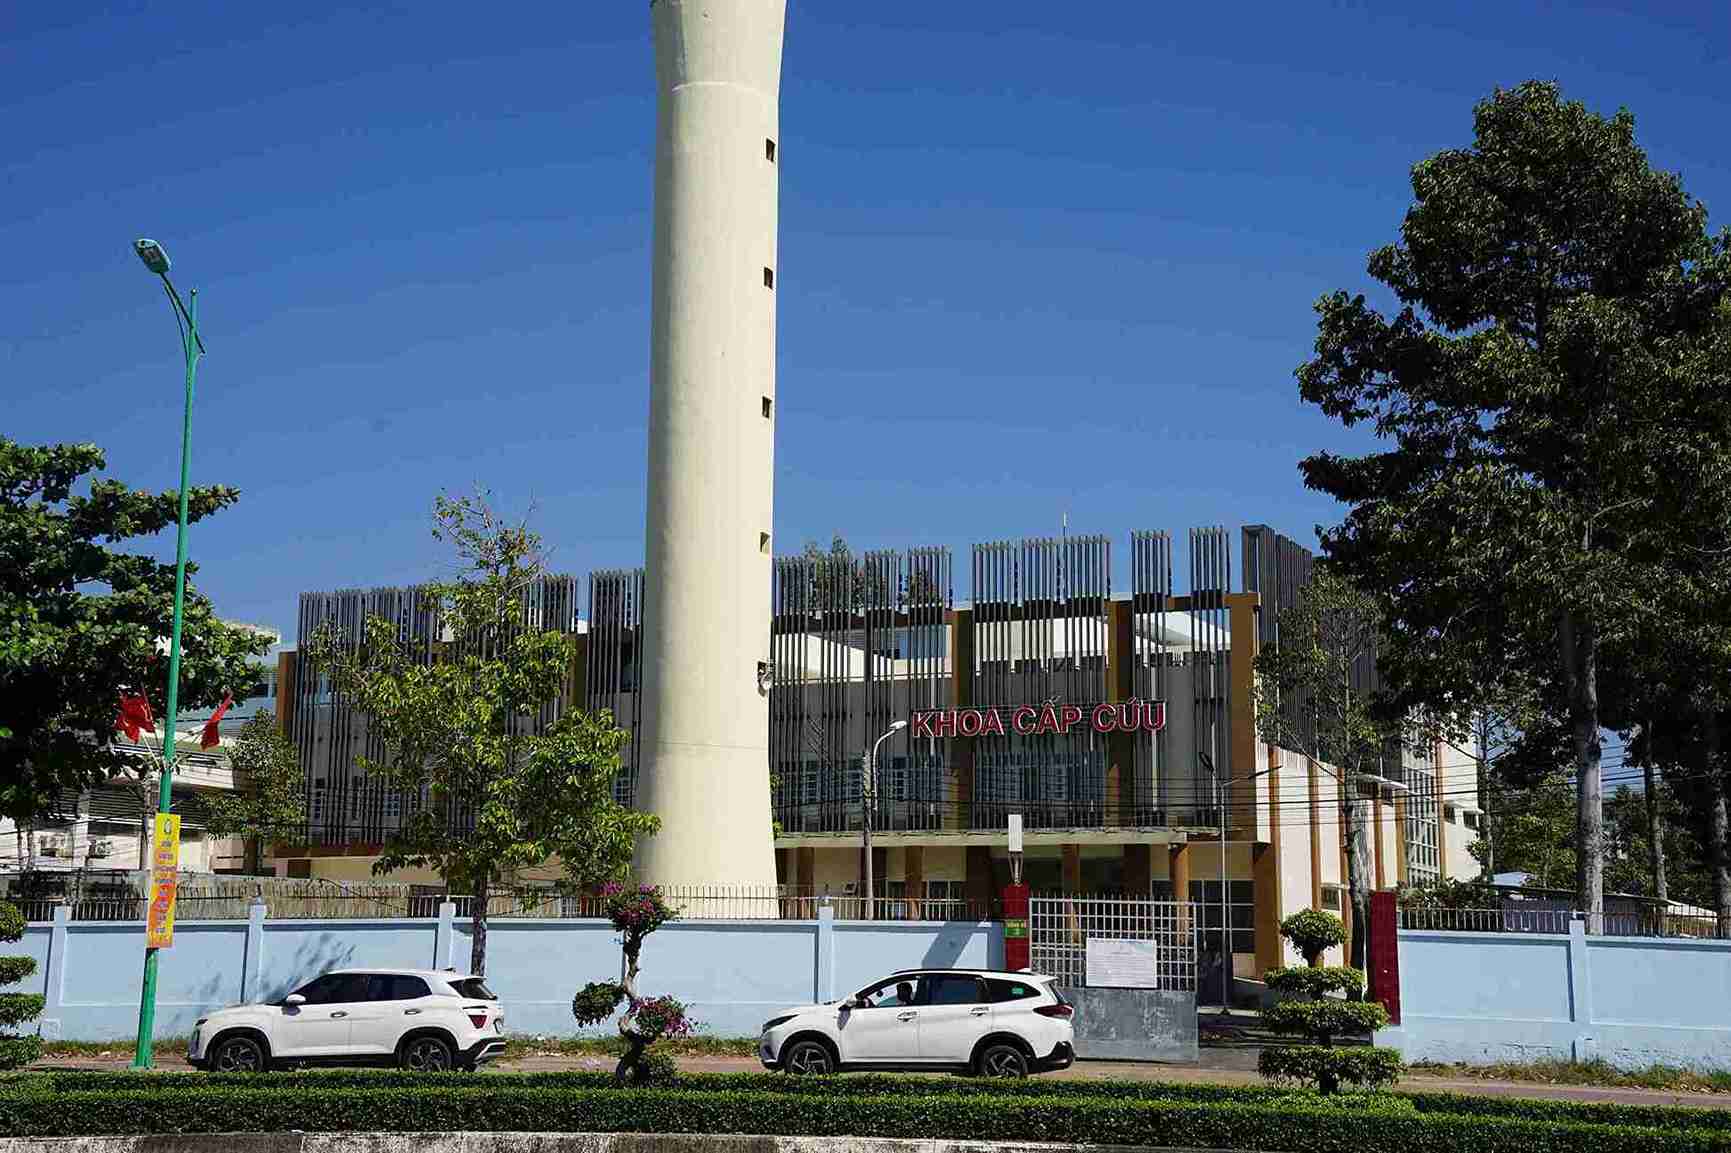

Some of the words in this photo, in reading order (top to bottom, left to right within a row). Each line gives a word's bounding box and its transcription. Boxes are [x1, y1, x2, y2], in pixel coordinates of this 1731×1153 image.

[912, 708, 1005, 737] KHOA
[1012, 696, 1082, 735] CẤP
[1092, 696, 1166, 732] CỨU
